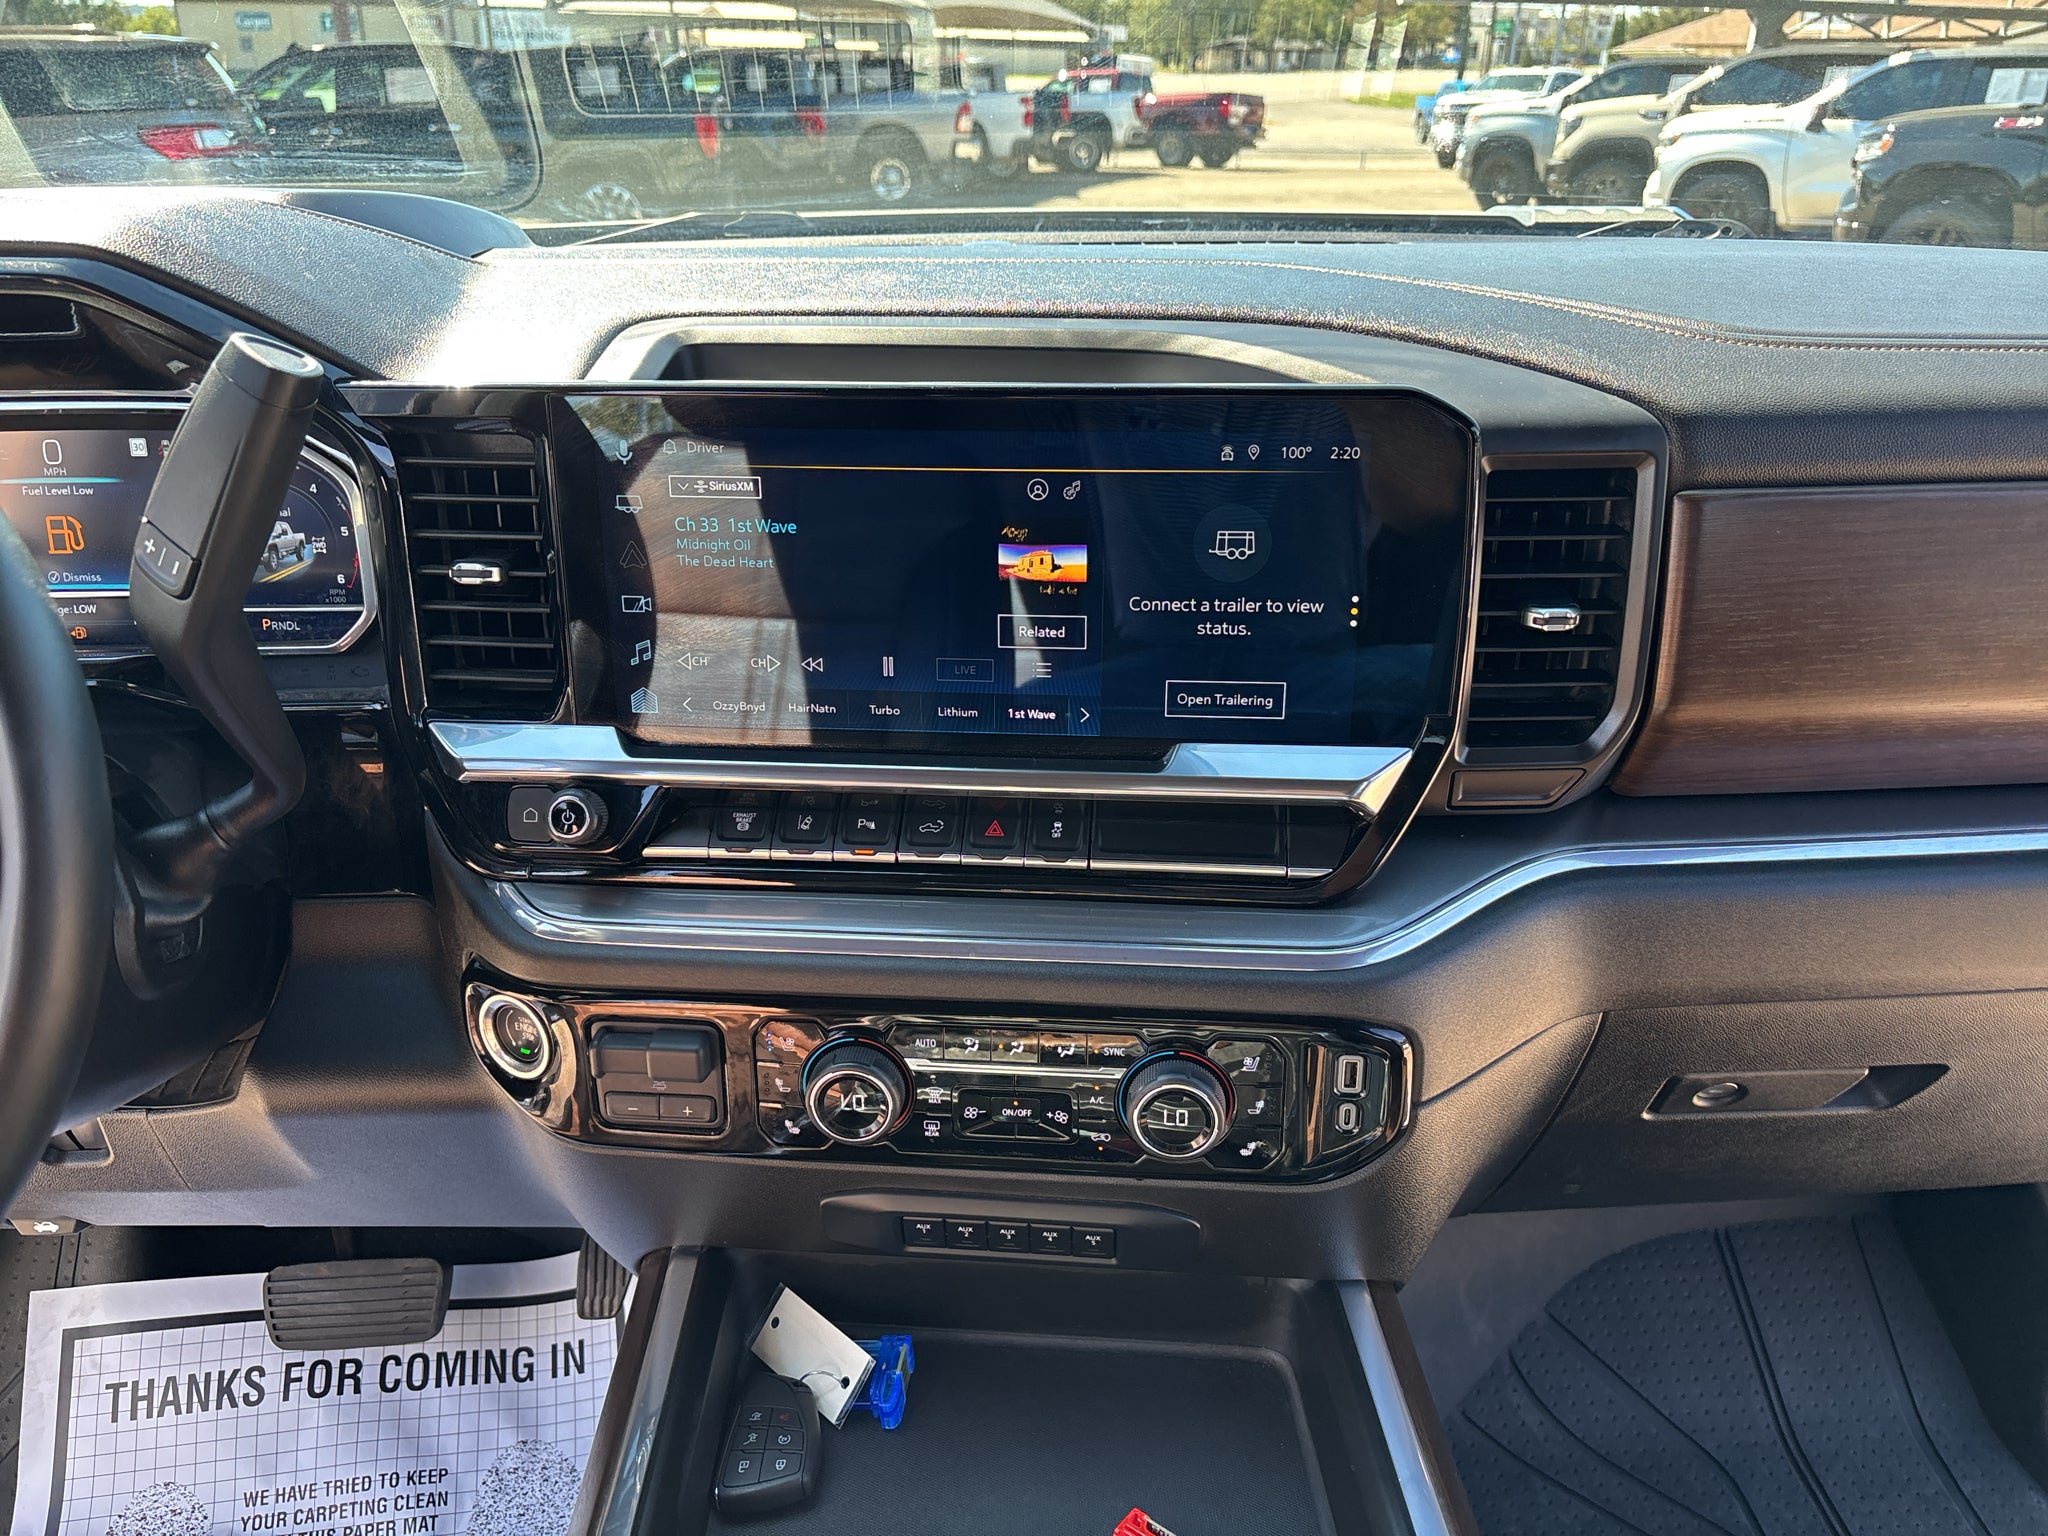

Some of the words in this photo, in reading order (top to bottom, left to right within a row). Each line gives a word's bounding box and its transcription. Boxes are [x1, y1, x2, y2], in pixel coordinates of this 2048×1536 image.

[132, 442, 145, 451] 30
[686, 441, 724, 454] Driver
[1329, 447, 1361, 460] 2:20
[43, 467, 67, 477] MPH
[22, 485, 43, 496] Fuel
[45, 485, 71, 496] Level
[73, 485, 94, 496] Low
[308, 483, 318, 494] 4
[708, 481, 754, 492] SiriusXM
[674, 516, 696, 532] Ch
[699, 517, 719, 532] 33
[728, 517, 752, 533] 1st
[756, 518, 797, 534] Wave
[340, 526, 349, 537] 5
[676, 538, 730, 553] Midnight
[733, 539, 751, 551] Oil
[677, 554, 700, 567] The
[703, 555, 736, 568] Dead
[739, 557, 774, 569] Heart
[62, 572, 102, 582] Dismiss
[336, 573, 346, 584] 6
[328, 588, 346, 597] RPM
[73, 604, 97, 614] LOW
[1129, 597, 1197, 613] Connect
[1200, 602, 1210, 613] a
[1213, 598, 1262, 614] trailer
[1266, 599, 1284, 614] to
[1286, 599, 1325, 614] view
[1018, 626, 1066, 638] Related
[1196, 622, 1252, 636] status.
[692, 656, 708, 667] CH
[750, 658, 766, 669] CH
[954, 665, 977, 676] LIVE
[712, 699, 766, 713] OzzyBnyd
[1176, 693, 1212, 709] Open
[1214, 694, 1274, 710] Trailering
[788, 702, 837, 715] HairNatn
[869, 704, 901, 716] Turbo
[937, 706, 979, 718] Lithium
[1007, 708, 1026, 719] 1st
[1028, 709, 1057, 721] Wave
[914, 1038, 937, 1049] AUTO
[1103, 1047, 1126, 1057] SYNC
[1089, 1096, 1105, 1105] A/C
[1001, 1108, 1032, 1118] ON/OFF
[999, 1228, 1016, 1236] AUX
[1041, 1231, 1058, 1239] AUX
[1084, 1234, 1101, 1242] AUX
[105, 1365, 266, 1424] THANKS
[281, 1357, 363, 1402] FOR
[378, 1346, 535, 1394] COMING
[550, 1338, 586, 1379] IN
[243, 1489, 270, 1508] WE
[275, 1482, 318, 1504] HAVE
[323, 1475, 372, 1497] TRIED
[378, 1471, 400, 1490] TO
[406, 1467, 449, 1487] KEEP
[241, 1511, 288, 1533] YOUR
[293, 1497, 388, 1525] CARPETING
[393, 1490, 449, 1513] CLEAN
[343, 1519, 396, 1536] PAPER
[402, 1514, 439, 1535] MAT
